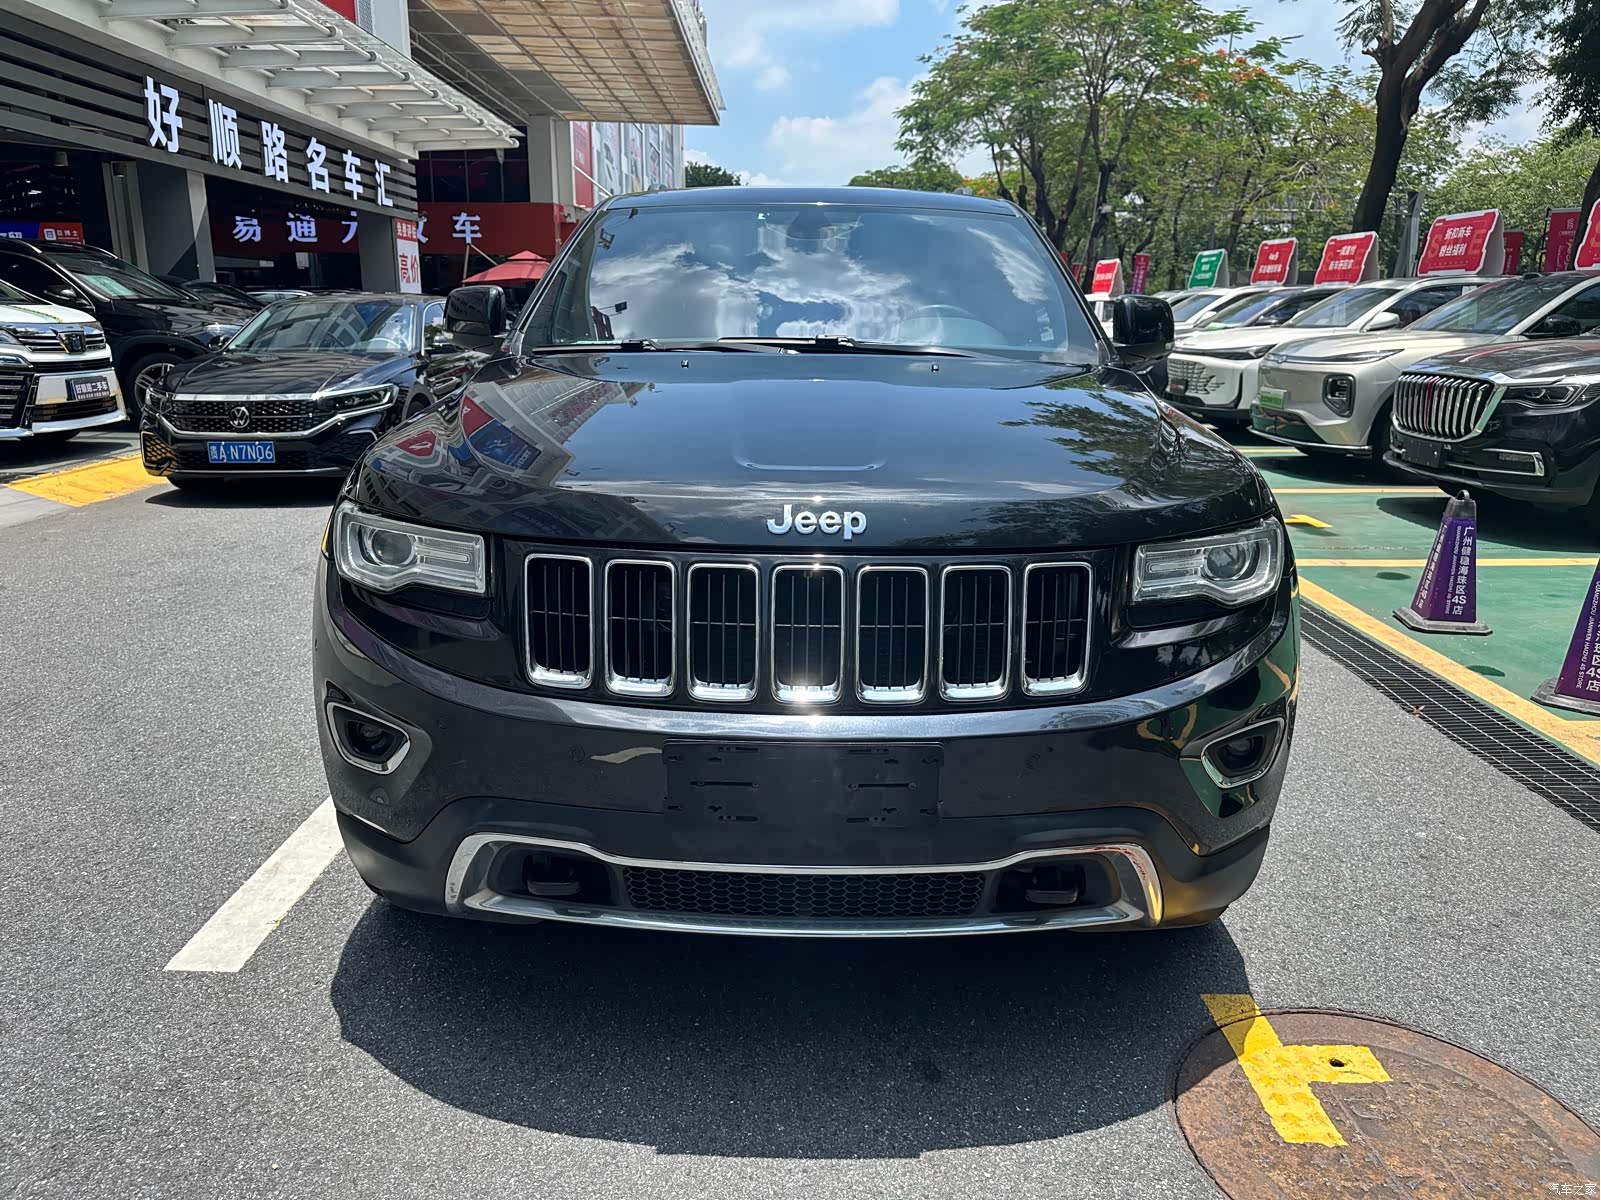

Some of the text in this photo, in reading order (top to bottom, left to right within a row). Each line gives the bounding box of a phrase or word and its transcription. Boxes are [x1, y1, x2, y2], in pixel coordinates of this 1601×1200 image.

[144, 76, 394, 207] 好顺路名车汇
[1444, 225, 1474, 240] 折扣新车
[1438, 242, 1468, 257] 粉丝福利
[766, 503, 868, 540] Jeep
[1453, 525, 1462, 555] GUANGZHOU
[1452, 525, 1475, 616] 广州健稳海珠区4S店
[1585, 615, 1594, 641] JIANWEN
[1581, 641, 1589, 663] HAIZHU
[1579, 662, 1585, 671] 4S
[1576, 671, 1584, 689] STORE
